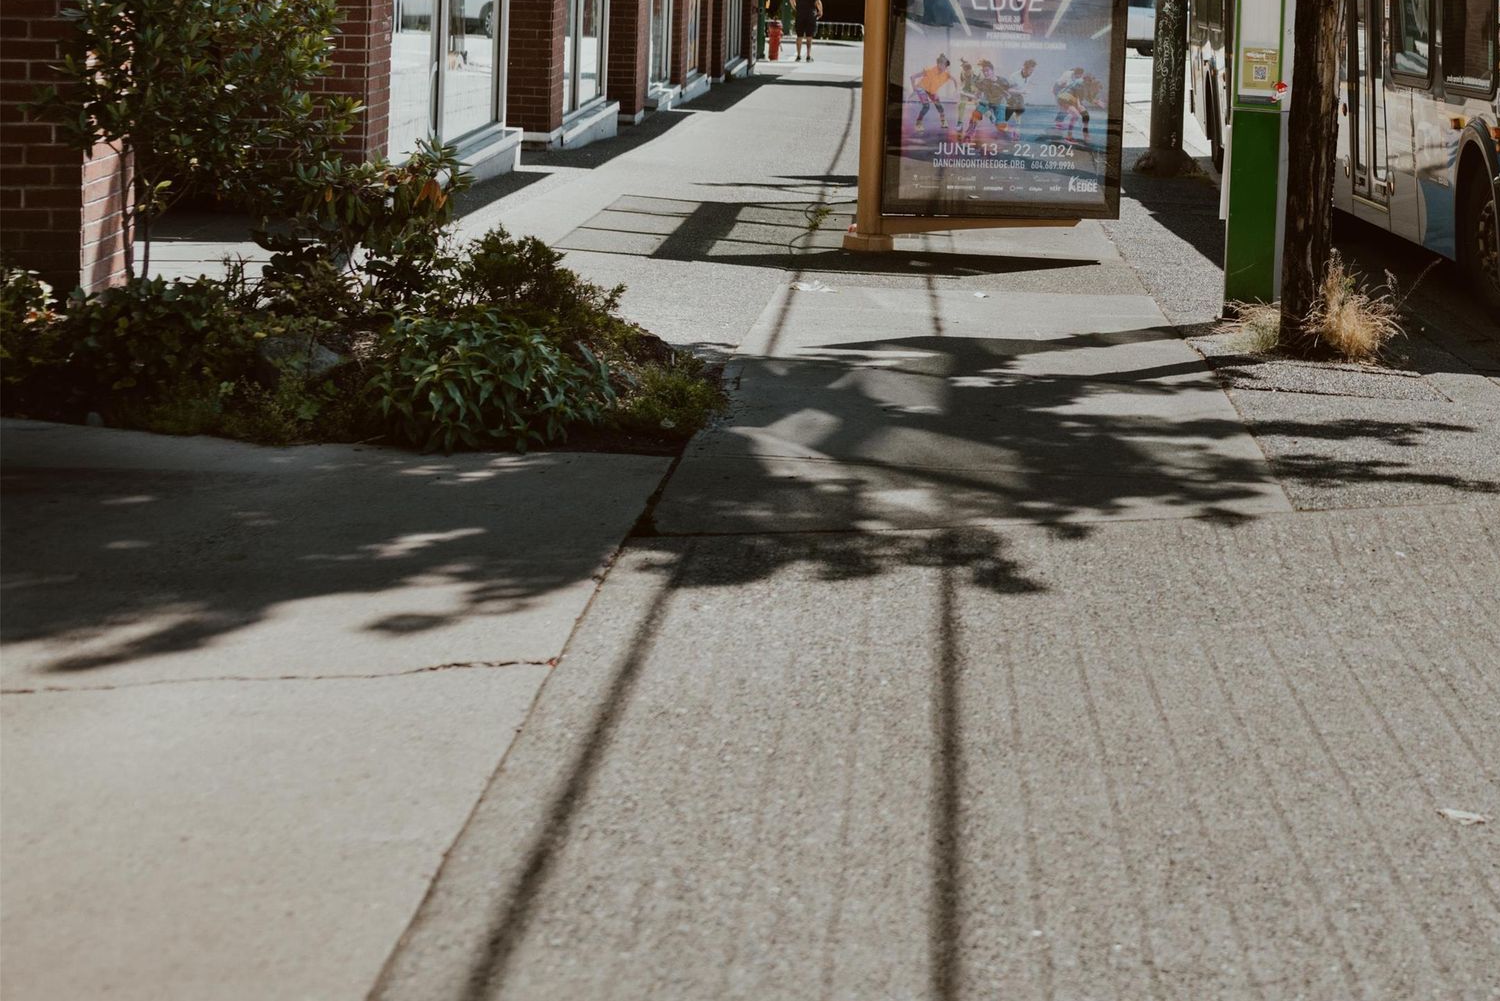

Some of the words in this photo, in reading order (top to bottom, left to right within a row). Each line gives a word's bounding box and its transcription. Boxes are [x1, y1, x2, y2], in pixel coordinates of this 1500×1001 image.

[934, 141, 977, 156] JUNE
[981, 142, 998, 156] 13
[1013, 143, 1036, 159] 22,
[1039, 143, 1075, 158] 2024
[932, 158, 1026, 170] DANCINGONTHEEDGE.ORG
[1077, 182, 1098, 193] EDGE
